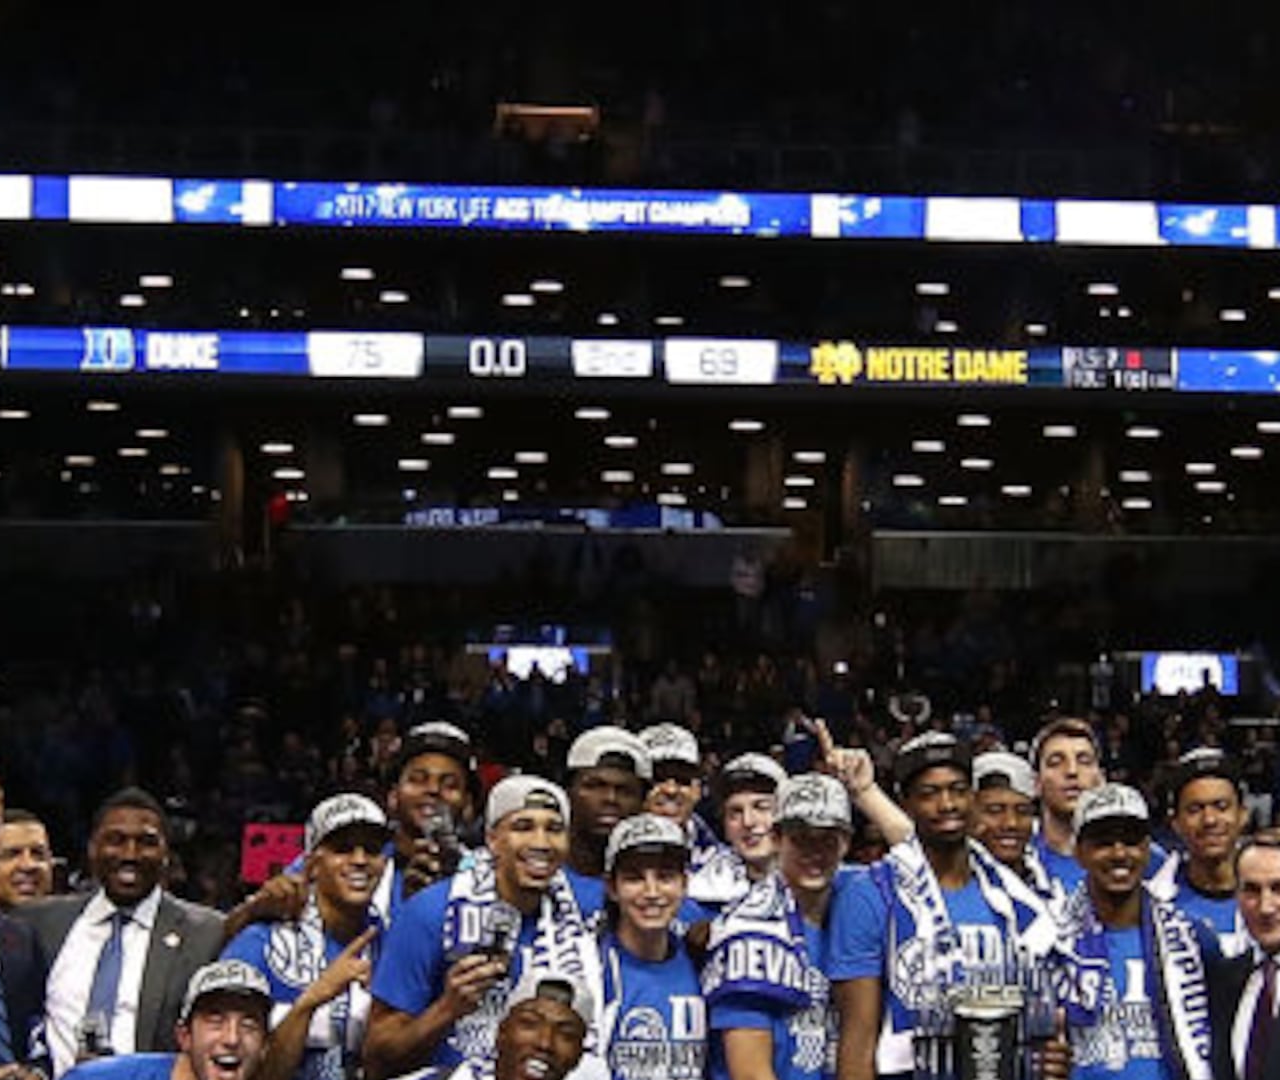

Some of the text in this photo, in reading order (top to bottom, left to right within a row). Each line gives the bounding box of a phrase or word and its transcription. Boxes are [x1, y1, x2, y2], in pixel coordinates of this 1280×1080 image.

[147, 333, 219, 369] DUKE
[347, 340, 382, 369] 75
[470, 340, 526, 375] 0.0
[699, 347, 739, 376] 69
[867, 348, 1028, 383] NOTRE DAME
